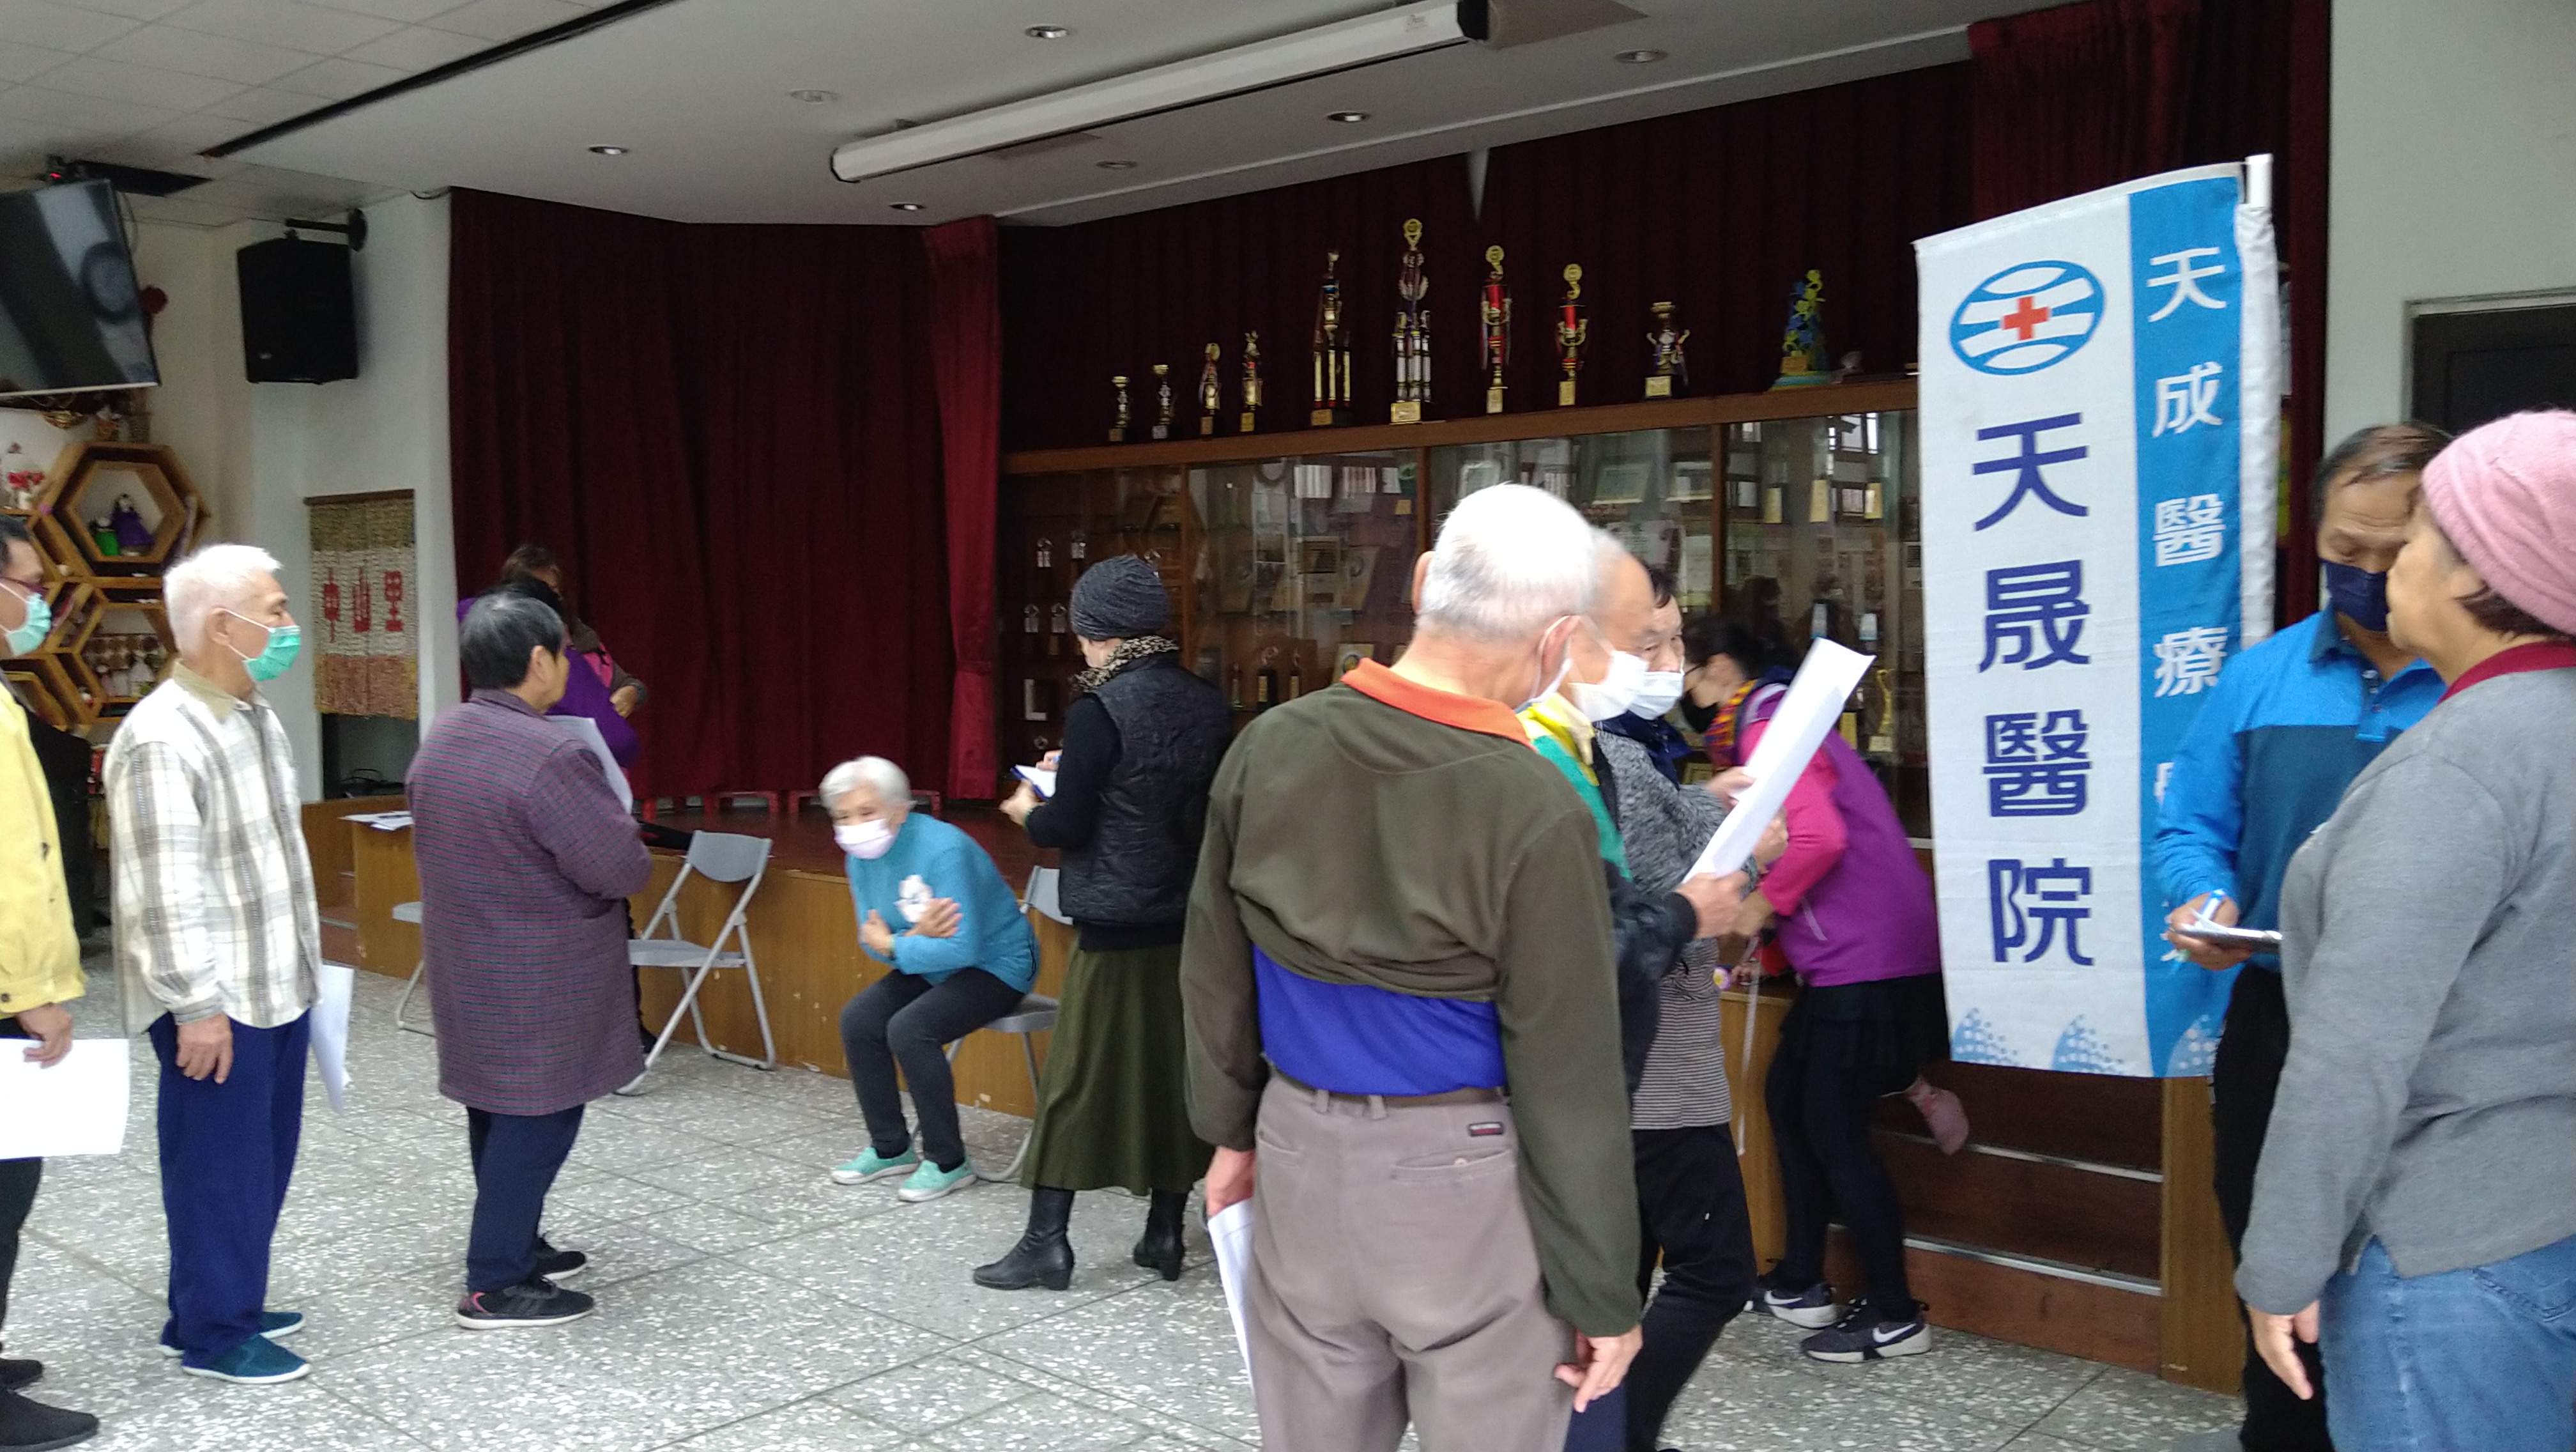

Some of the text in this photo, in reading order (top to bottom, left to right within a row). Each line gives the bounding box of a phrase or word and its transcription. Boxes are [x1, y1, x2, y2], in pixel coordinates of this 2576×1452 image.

[323, 566, 404, 643] 中山里
[1972, 412, 2095, 966] 天晟醫院
[2147, 246, 2228, 962] 天成醫療
